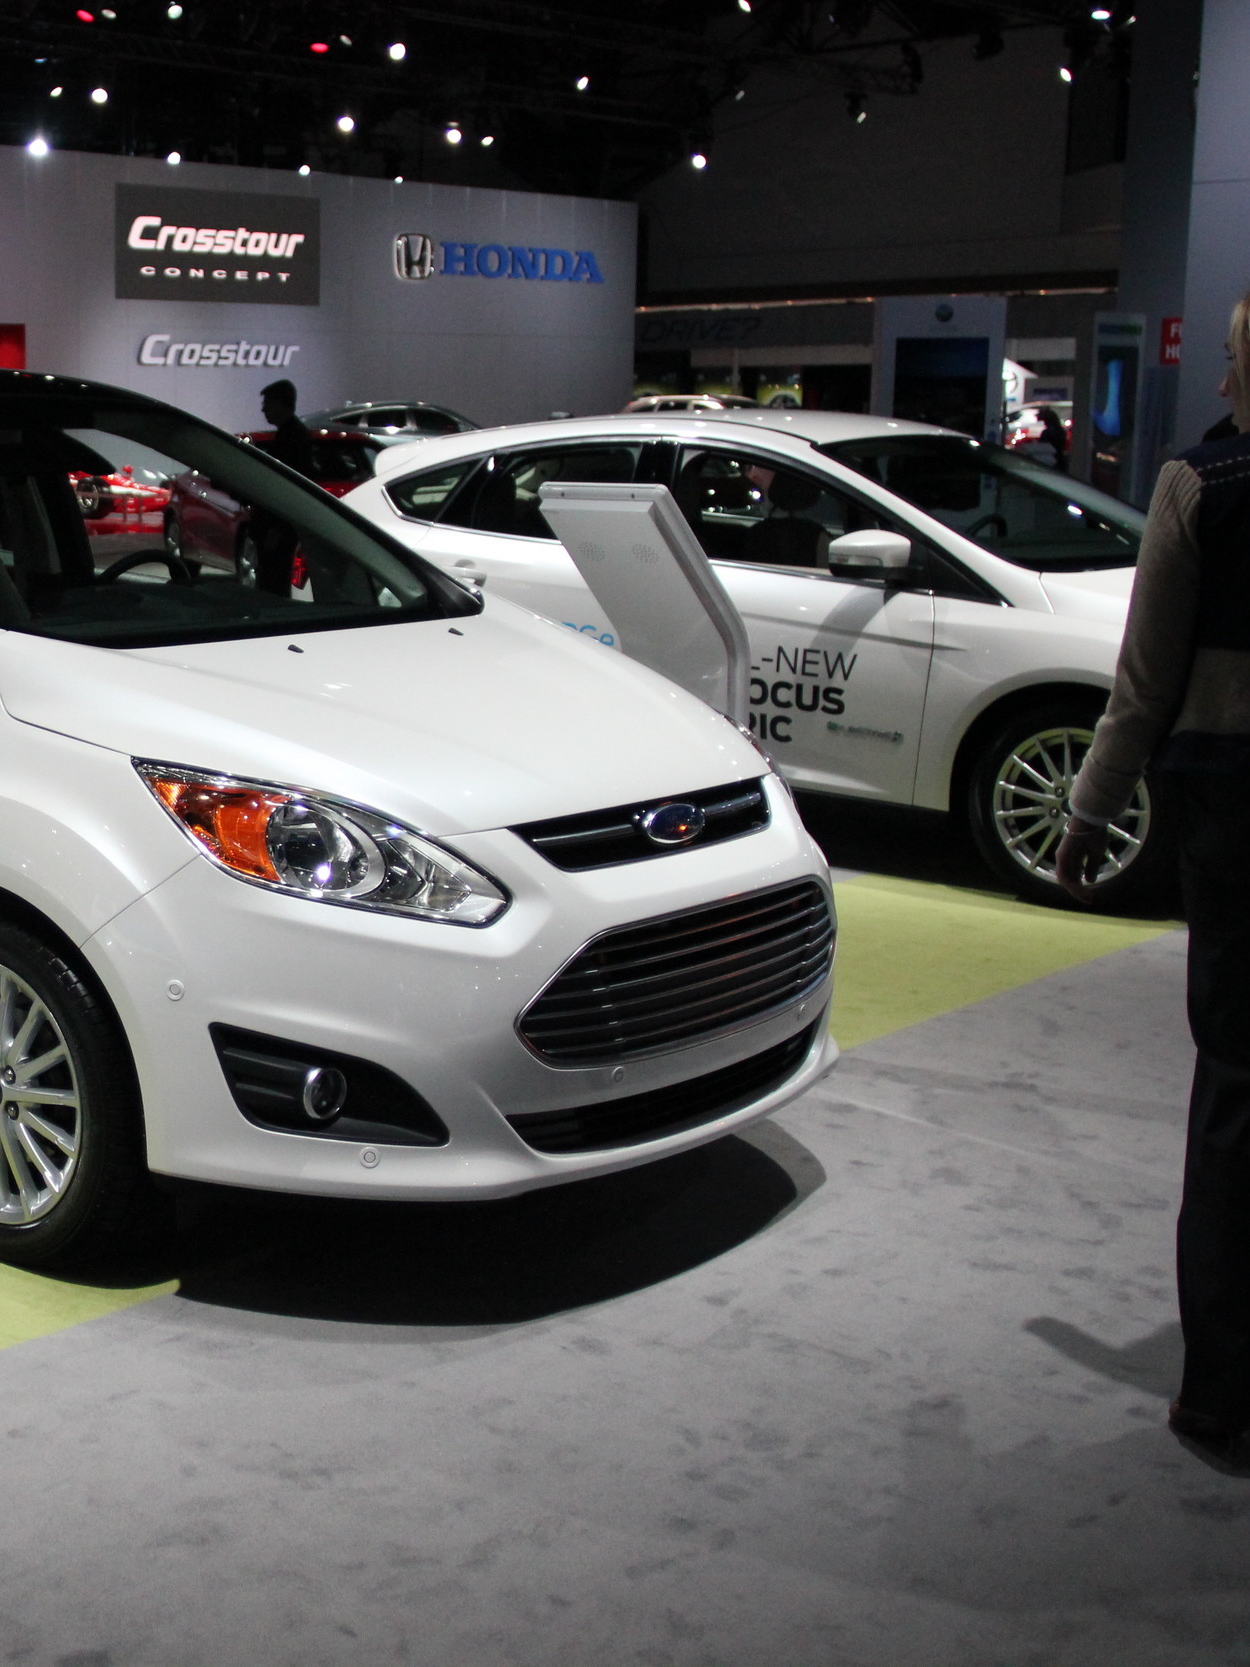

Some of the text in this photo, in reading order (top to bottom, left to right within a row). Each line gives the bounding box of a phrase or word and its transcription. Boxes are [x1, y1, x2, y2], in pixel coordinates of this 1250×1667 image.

[128, 215, 305, 258] Crosstour
[140, 265, 290, 283] CONCEPT
[440, 241, 606, 284] HONDA
[139, 334, 300, 367] Crosstour
[751, 645, 858, 681] -NEW
[750, 677, 845, 715] OCUS
